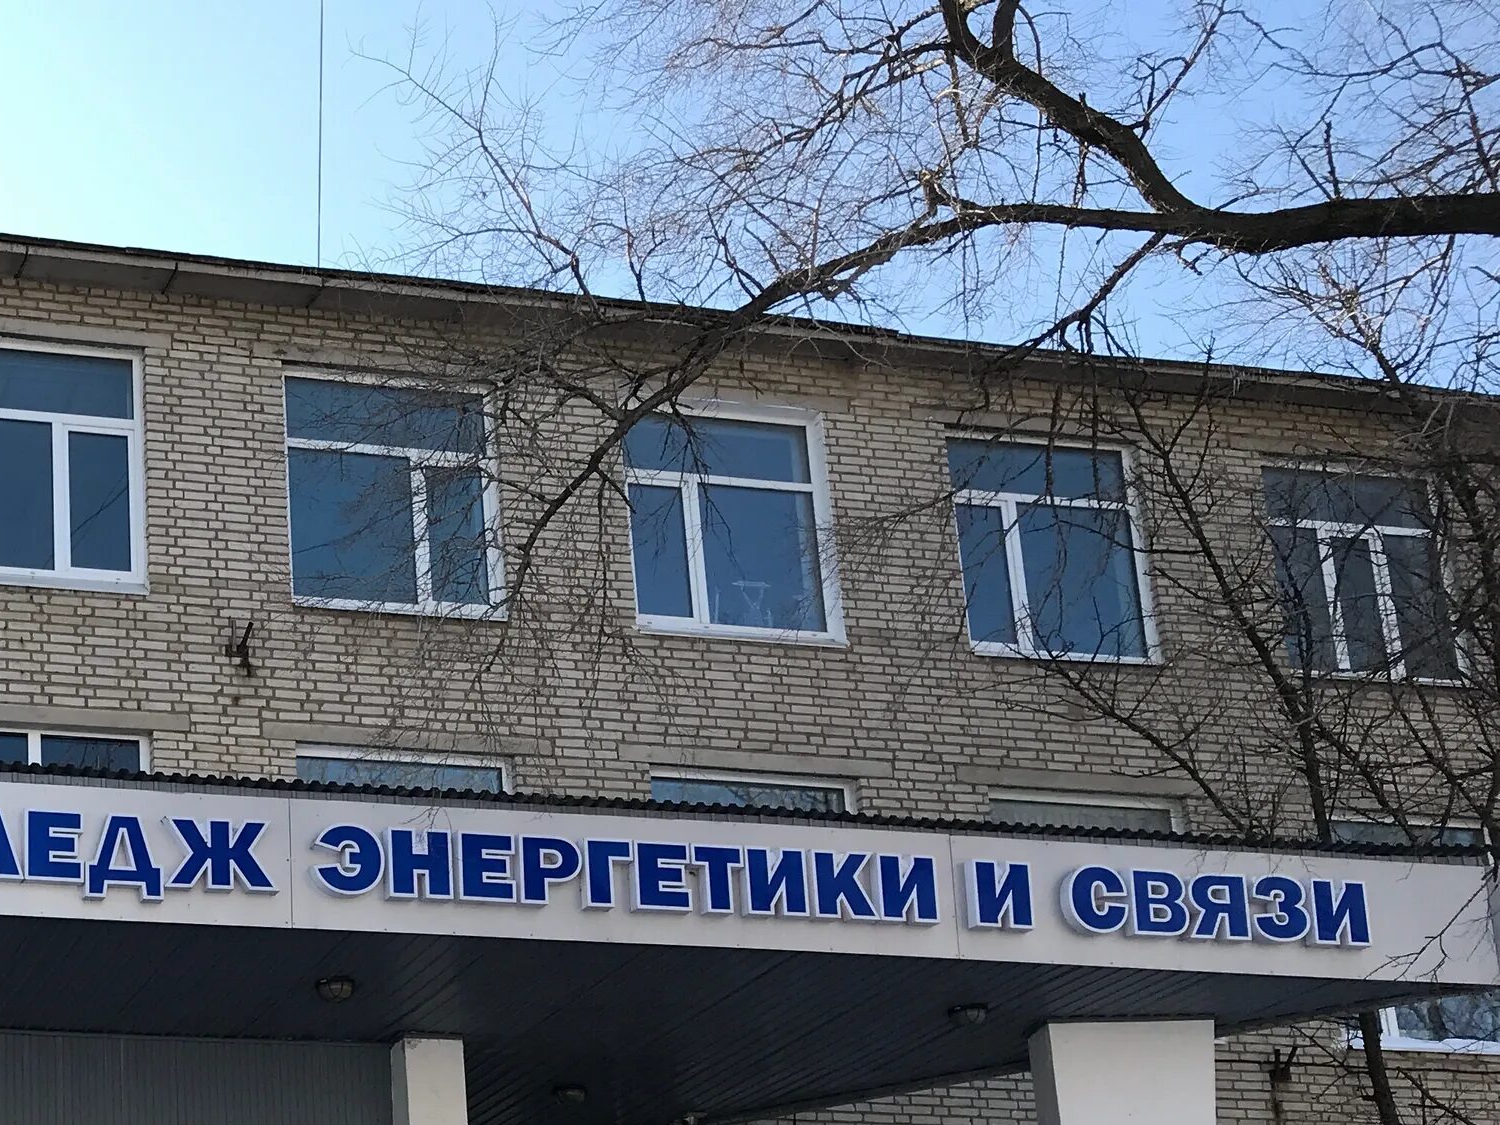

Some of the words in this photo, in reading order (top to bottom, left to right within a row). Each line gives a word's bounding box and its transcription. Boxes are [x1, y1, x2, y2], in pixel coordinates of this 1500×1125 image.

[313, 822, 939, 924] ЭНЕРГЕТИКИ
[967, 860, 1034, 930] И
[1063, 865, 1372, 948] СВЯЗИ
